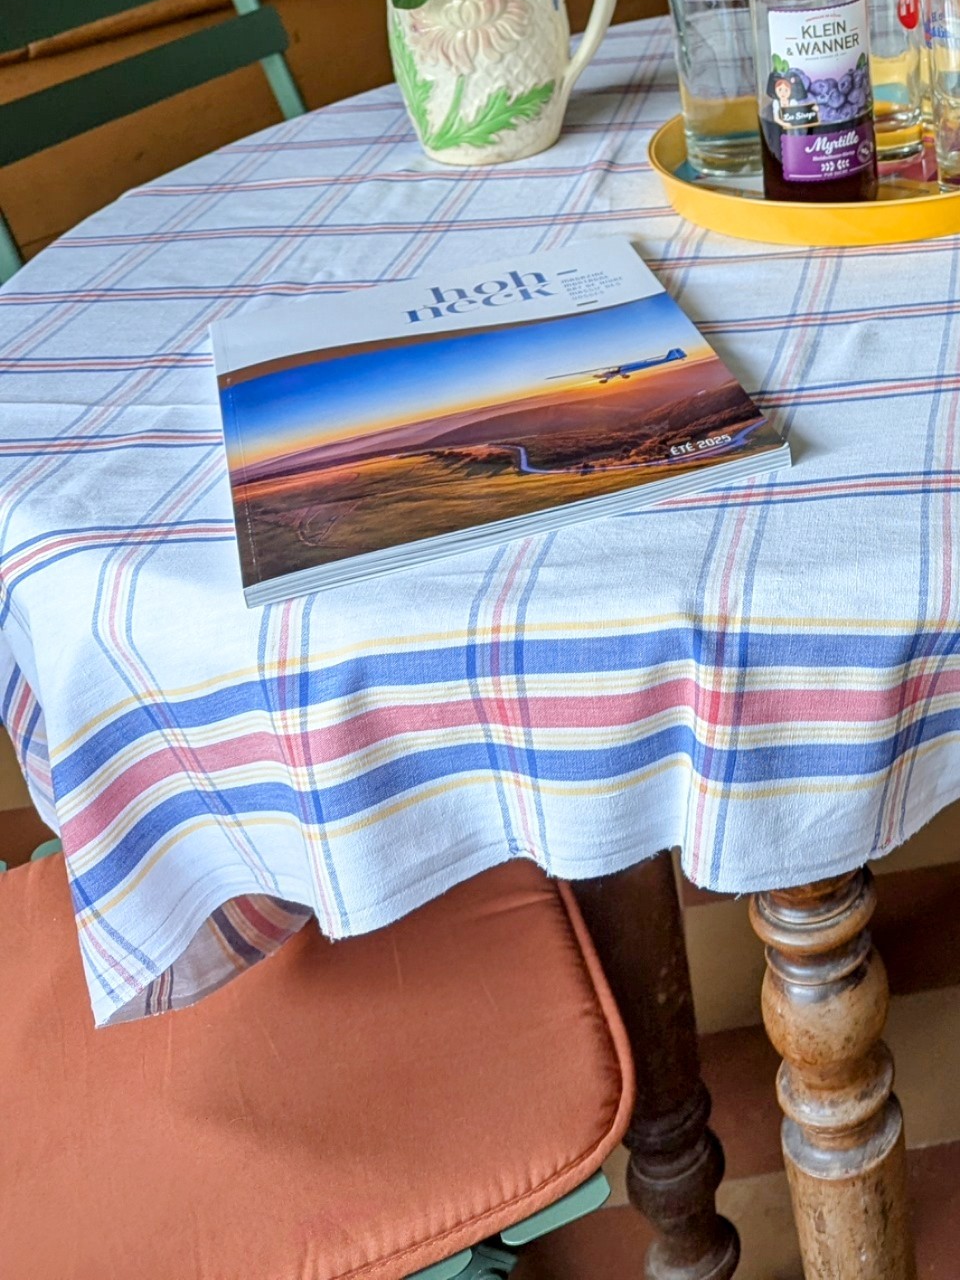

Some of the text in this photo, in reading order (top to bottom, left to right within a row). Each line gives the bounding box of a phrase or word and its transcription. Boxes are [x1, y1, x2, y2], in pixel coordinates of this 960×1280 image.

[801, 19, 847, 40] KLEIN
[786, 32, 860, 56] & WANNER
[805, 130, 860, 154] Myrtille
[428, 270, 549, 305] hoh
[404, 283, 558, 323] neck
[669, 433, 733, 456] ÉTÉ 2025
